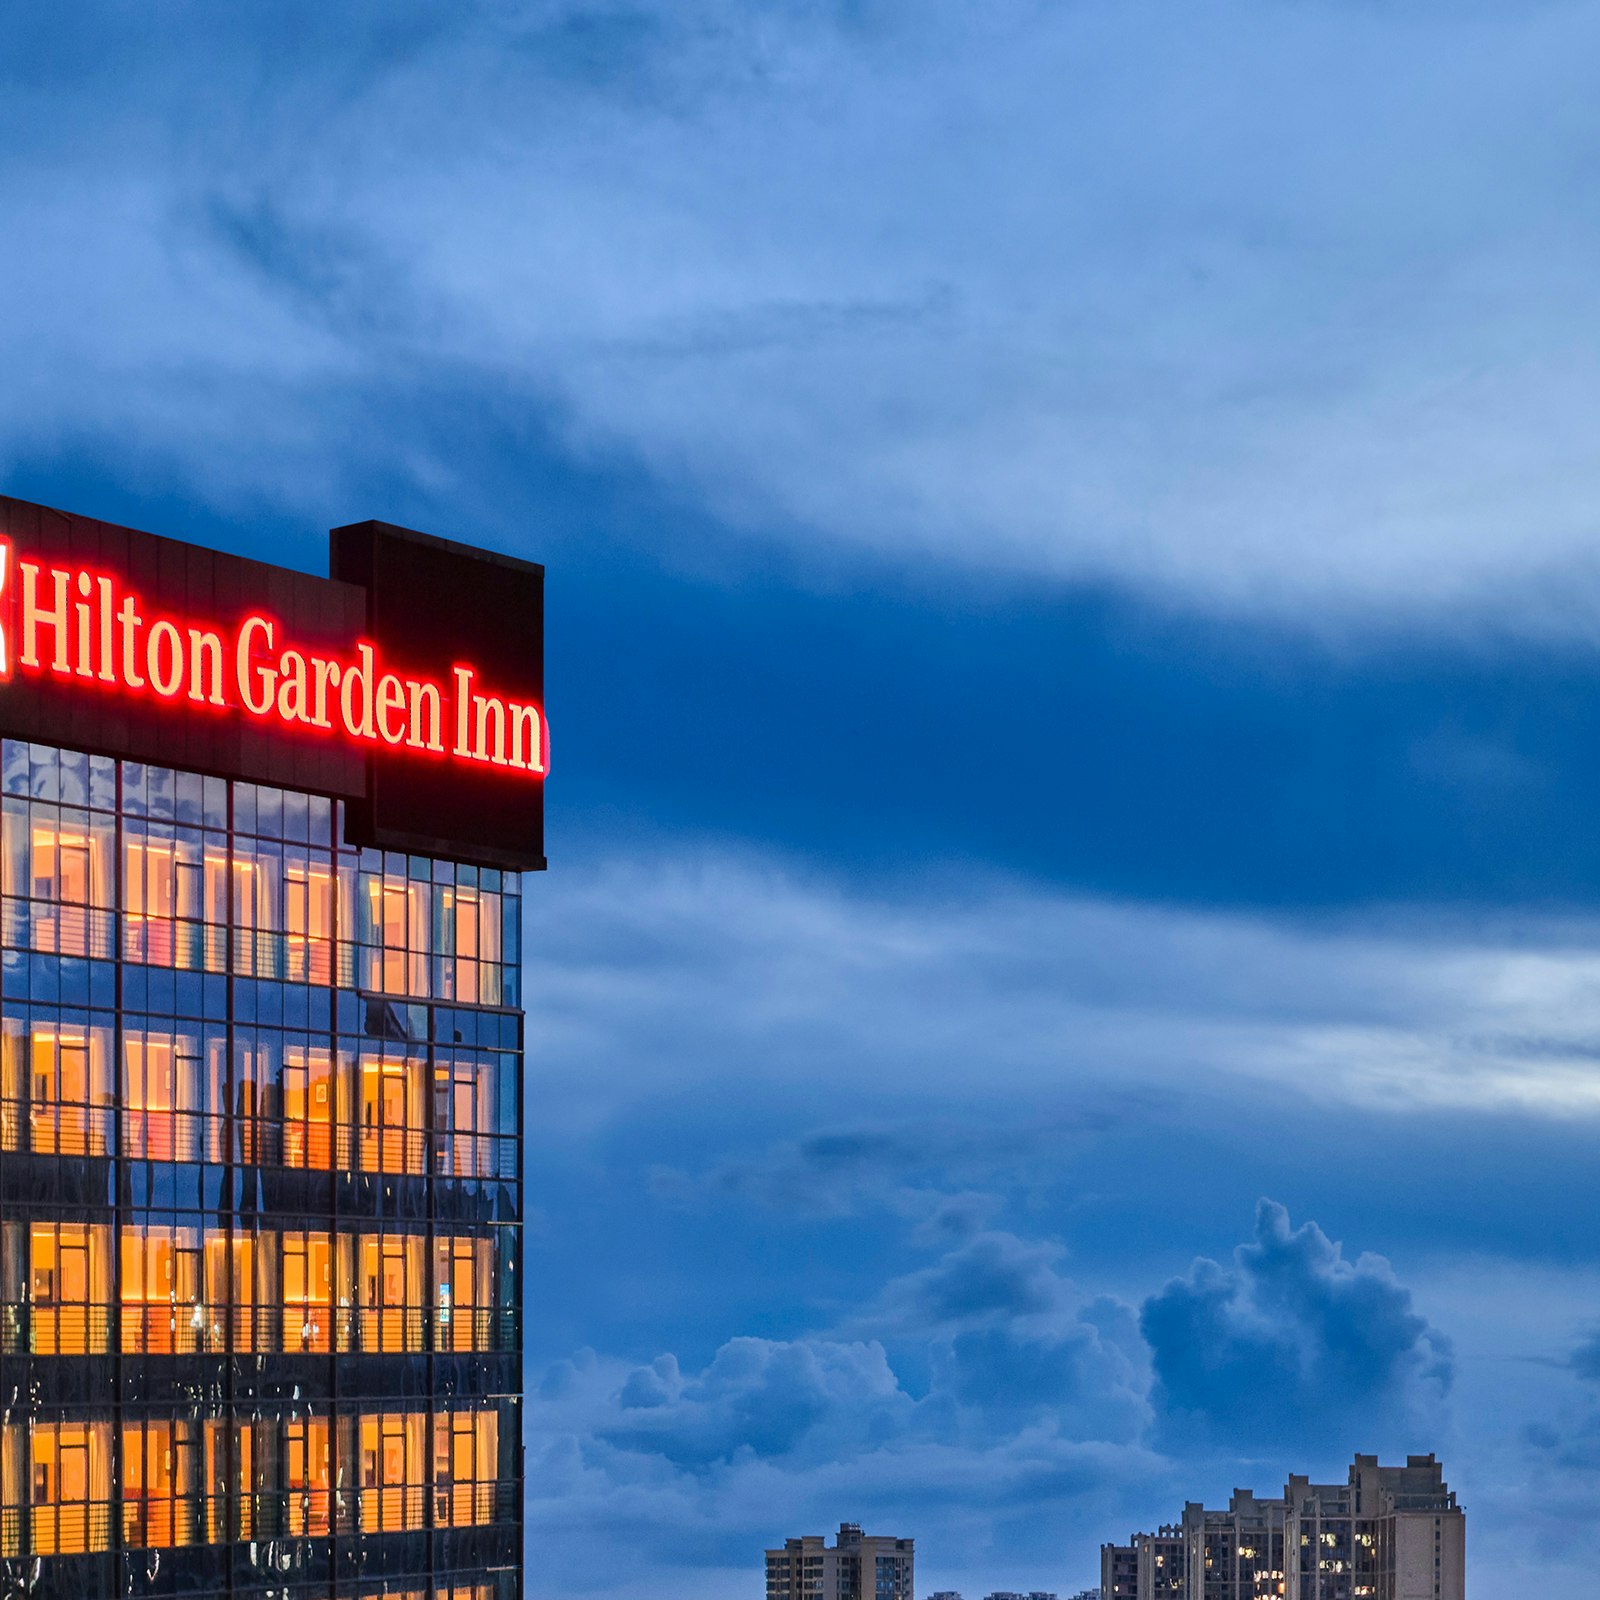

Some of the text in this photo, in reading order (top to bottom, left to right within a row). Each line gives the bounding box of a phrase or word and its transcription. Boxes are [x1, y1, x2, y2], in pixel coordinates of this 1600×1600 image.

[19, 562, 544, 773] Hilton Garden Inn
